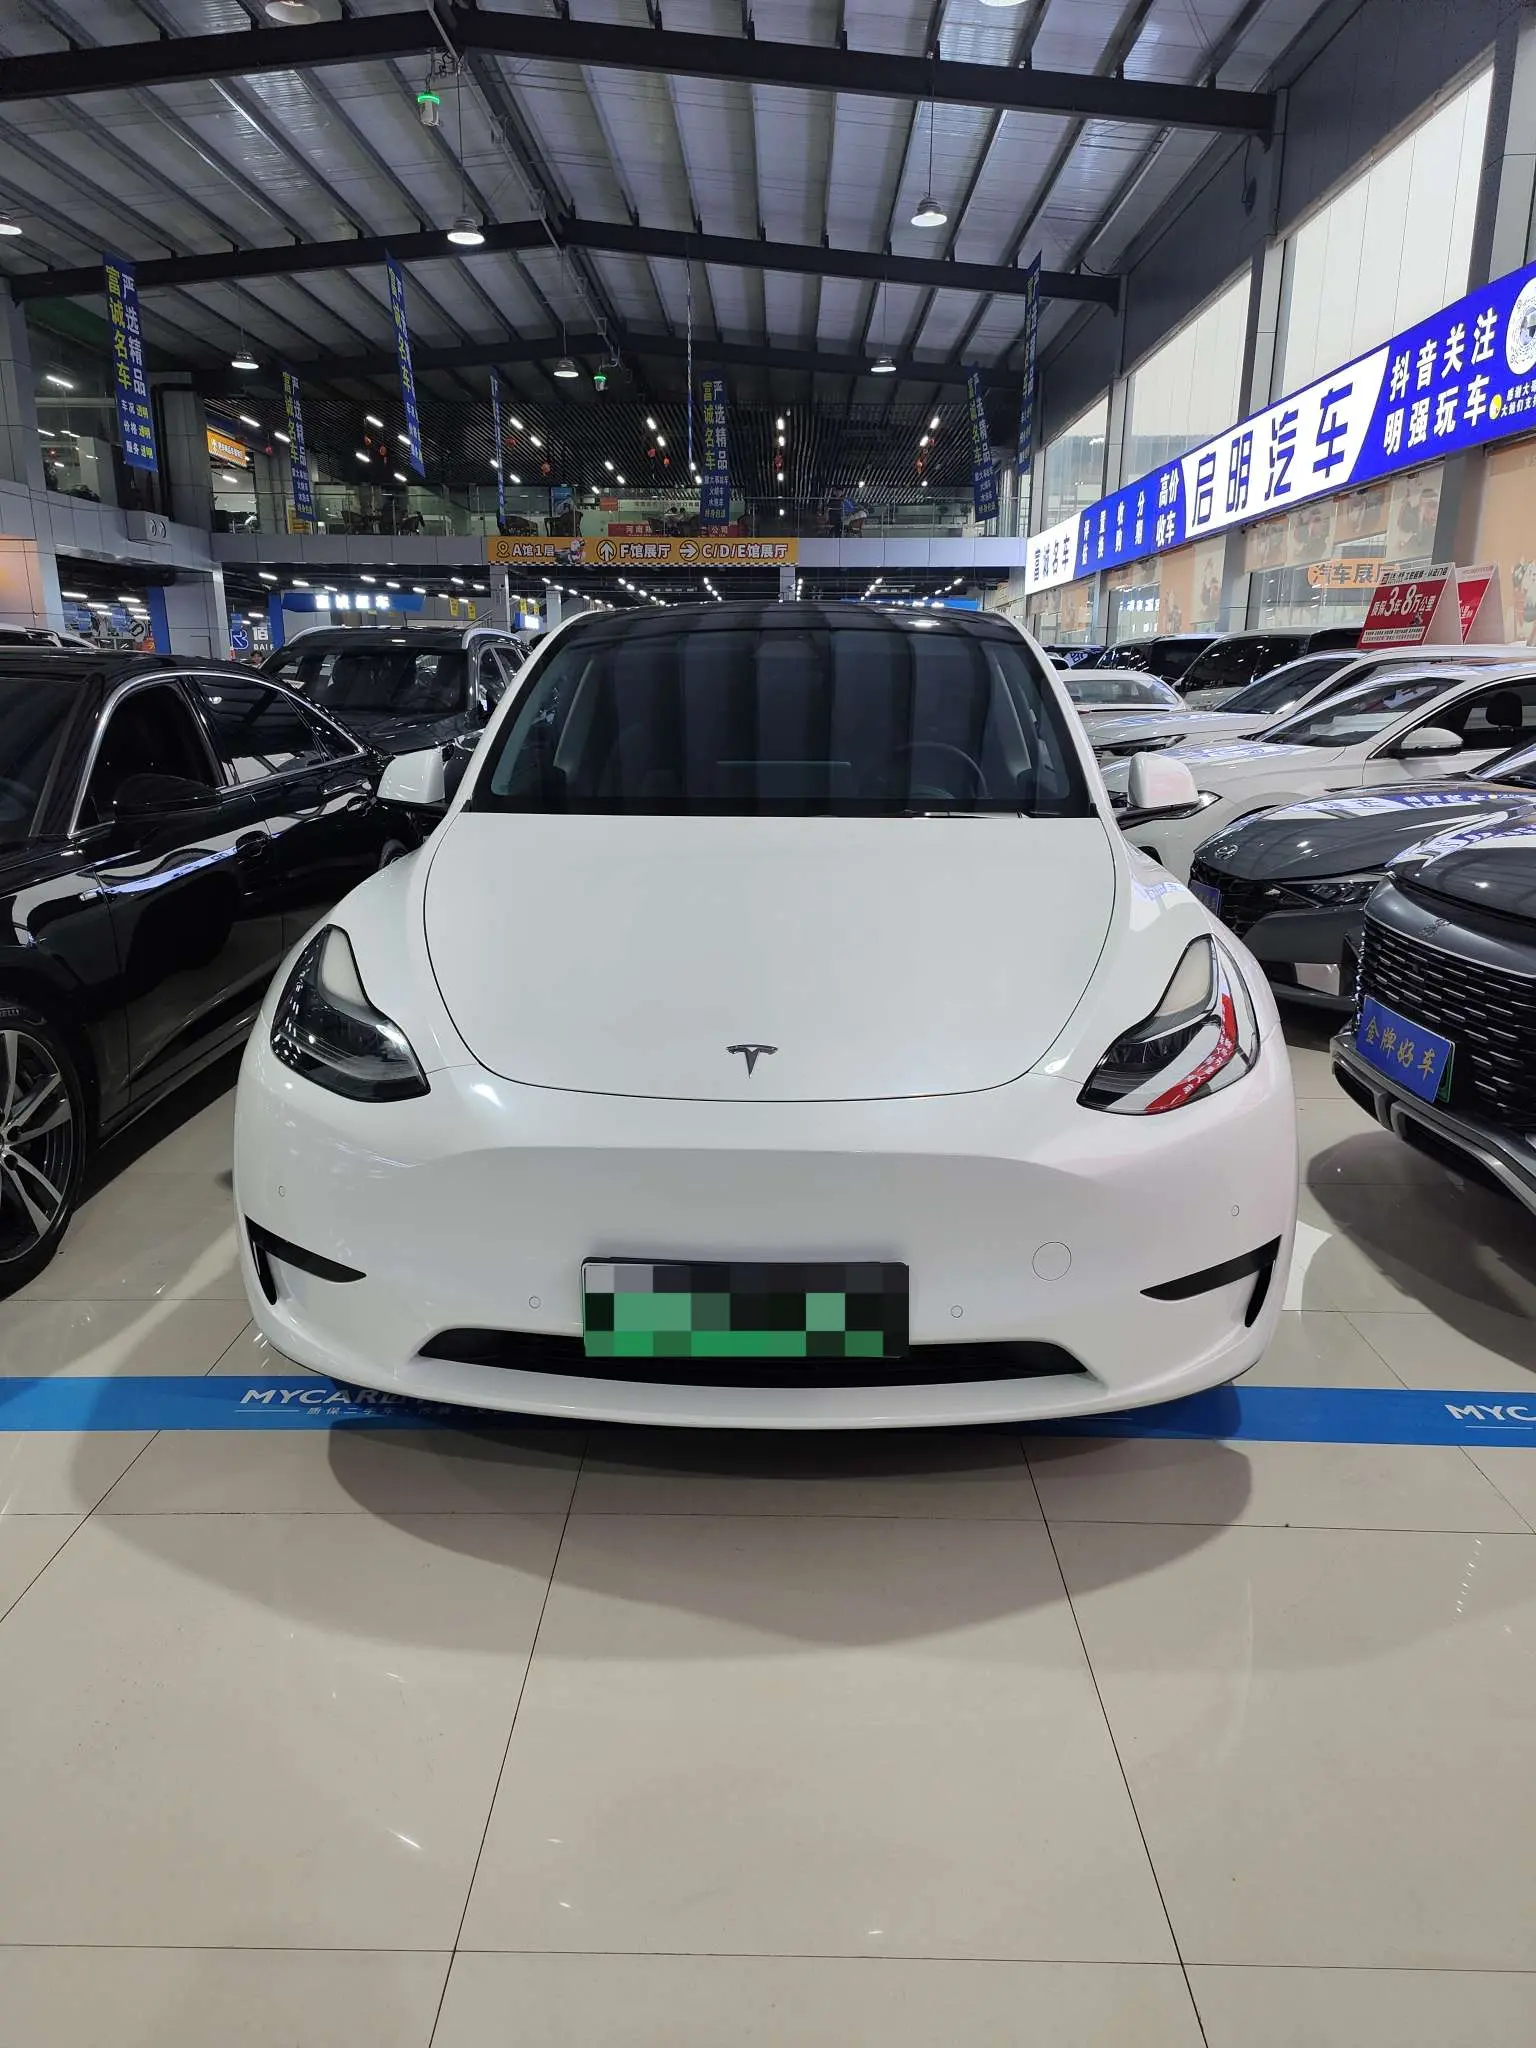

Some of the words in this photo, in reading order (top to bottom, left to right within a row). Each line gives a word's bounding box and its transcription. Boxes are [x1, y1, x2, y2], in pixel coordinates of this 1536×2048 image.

[106, 265, 132, 390] 富诚名车
[122, 272, 146, 397] 严选精品
[1389, 307, 1498, 402] 抖音关注
[703, 381, 716, 470] 富诚名车
[713, 380, 728, 470] 严选精品
[1192, 382, 1354, 527] 启明汽车
[1383, 374, 1490, 456] 明强玩车
[1155, 510, 1177, 548] 收车
[1159, 468, 1179, 508] 高价
[620, 543, 671, 558] F馆展厅
[702, 543, 788, 559] C/D/E馆展厅
[1370, 584, 1437, 617] 质保3年8万公里
[240, 1388, 425, 1405] MYCARE
